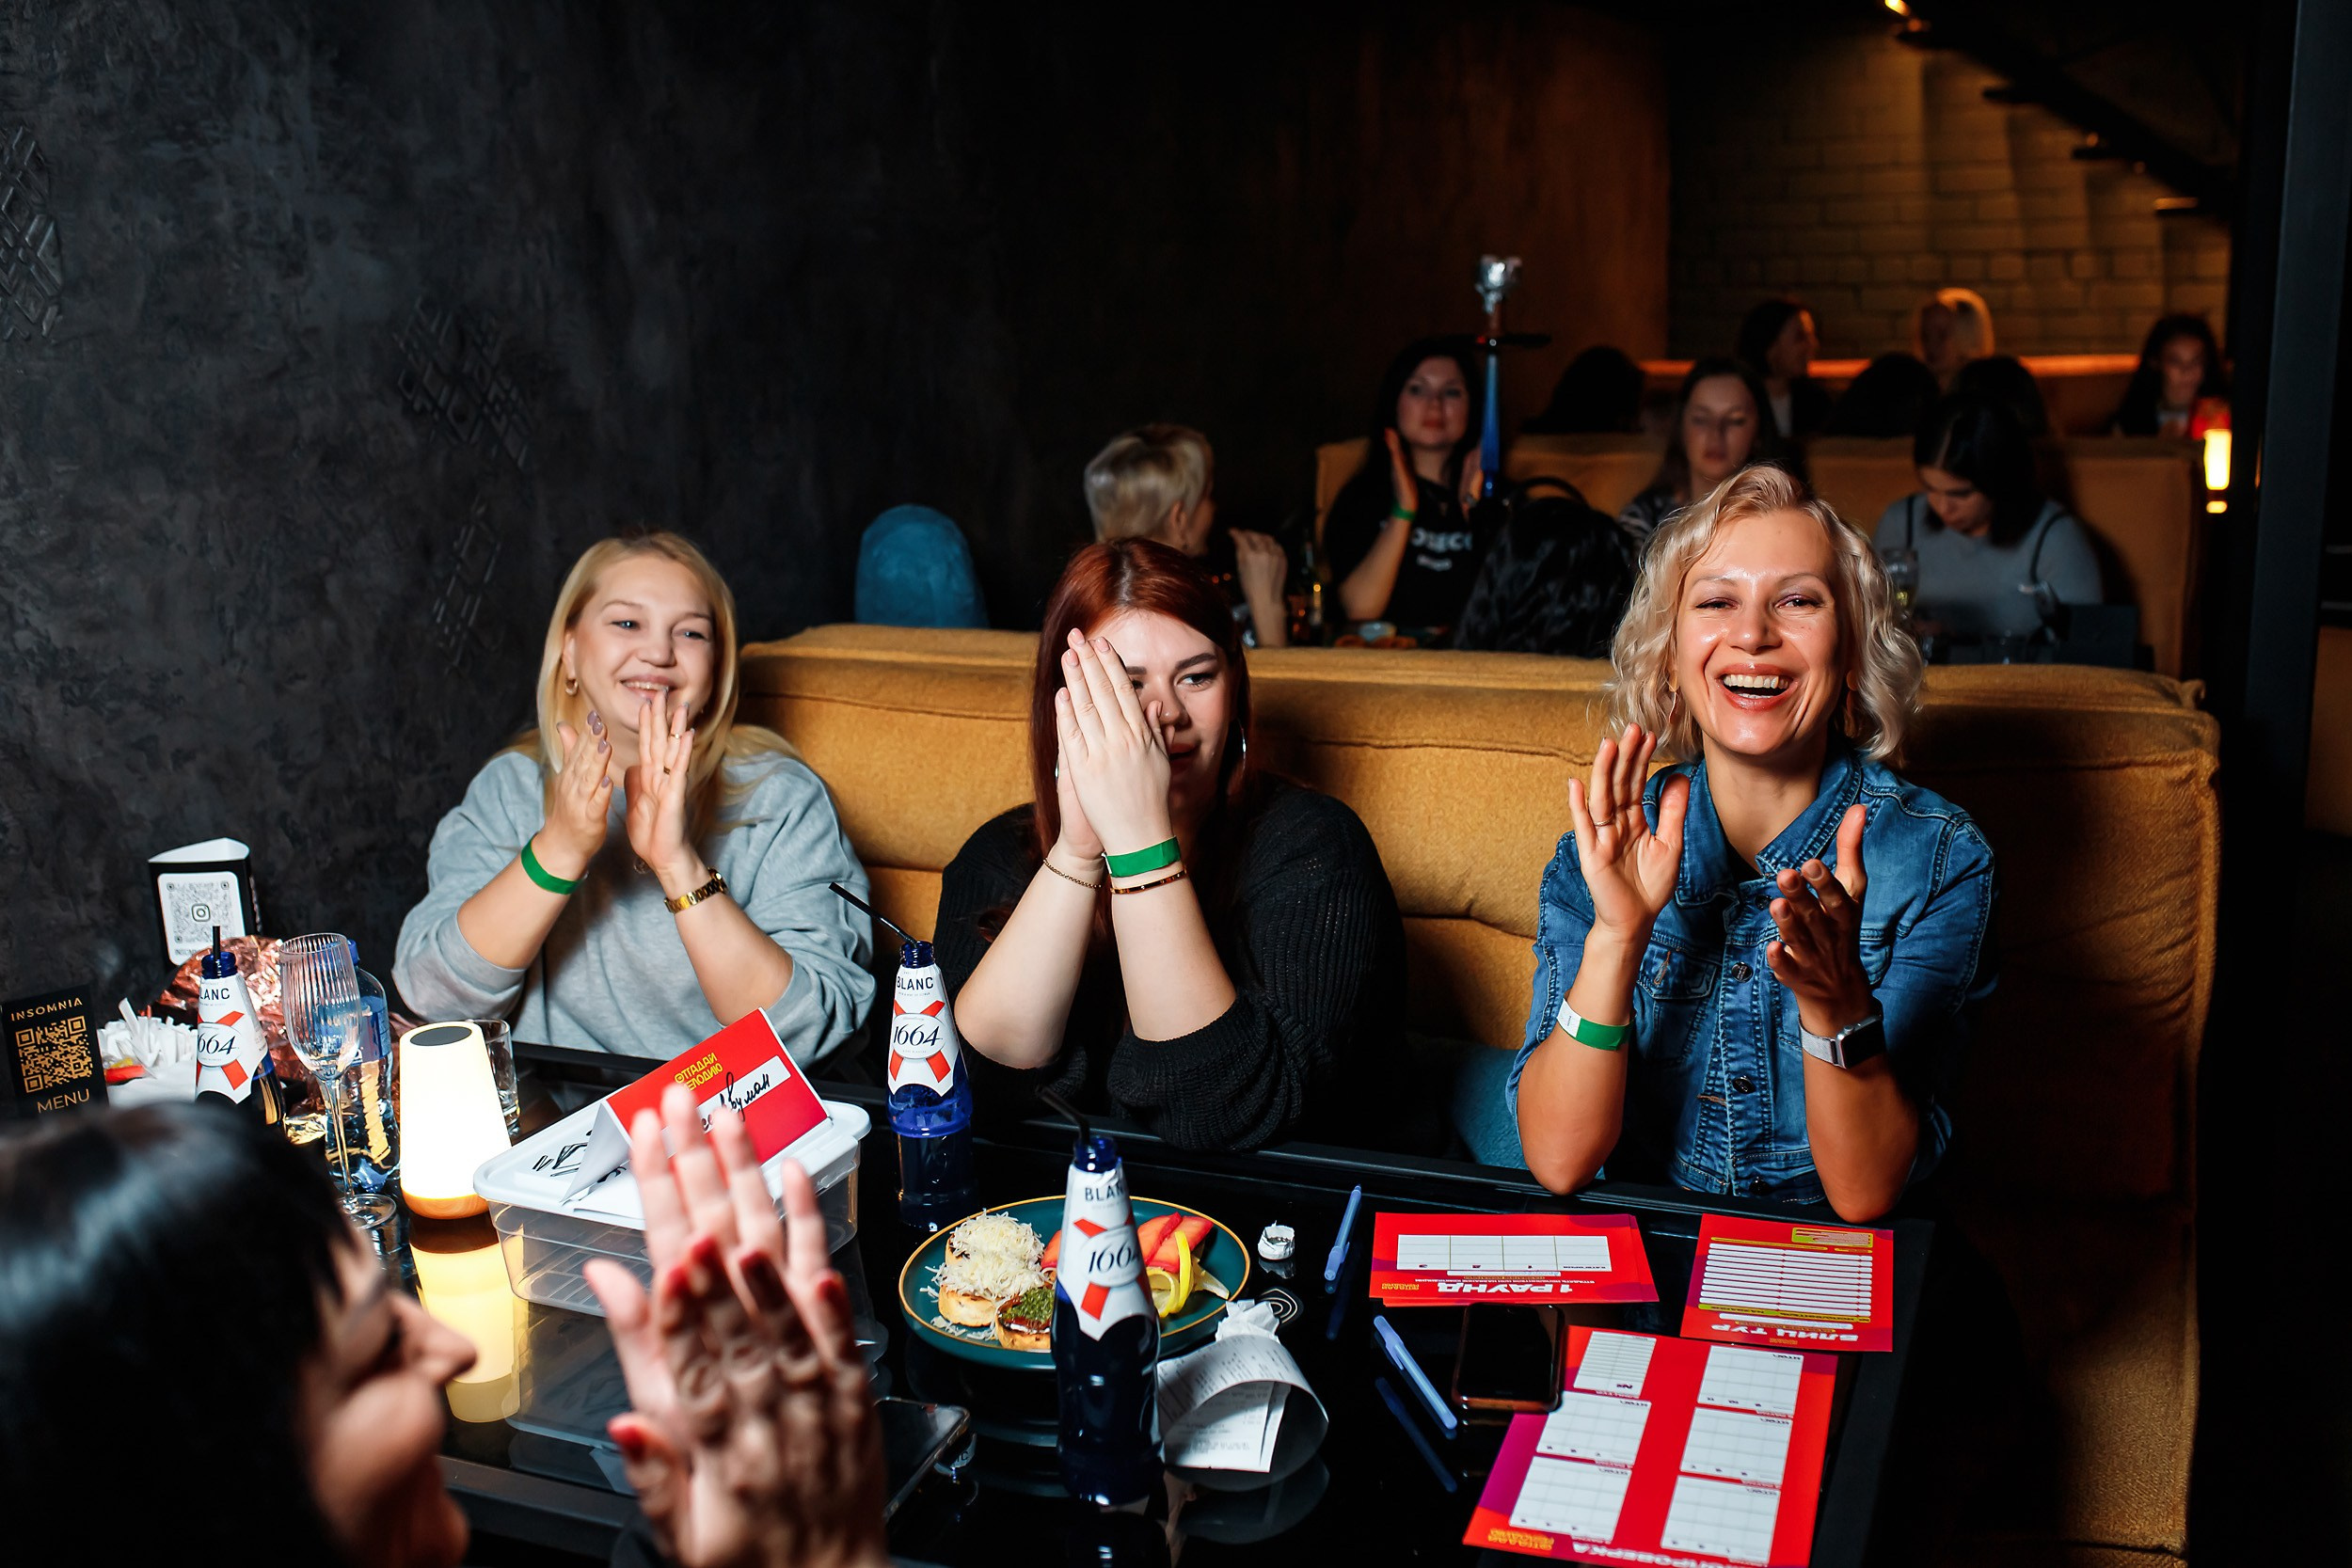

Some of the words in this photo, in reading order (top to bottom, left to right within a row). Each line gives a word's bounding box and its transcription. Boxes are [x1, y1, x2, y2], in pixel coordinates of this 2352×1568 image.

[896, 975, 934, 990] BLANC
[199, 988, 230, 1001] LANC
[10, 997, 84, 1022] INSOMNIA
[893, 1023, 944, 1047] 1664
[198, 1032, 240, 1055] 664
[684, 1062, 723, 1091] ЕЛОДИЮ
[37, 1088, 90, 1114] MENU
[1438, 1282, 1553, 1293] РАУНД
[1559, 1283, 1573, 1293] 1
[1710, 1323, 1768, 1336] ТУР
[1777, 1327, 1859, 1342] БЛИЦ
